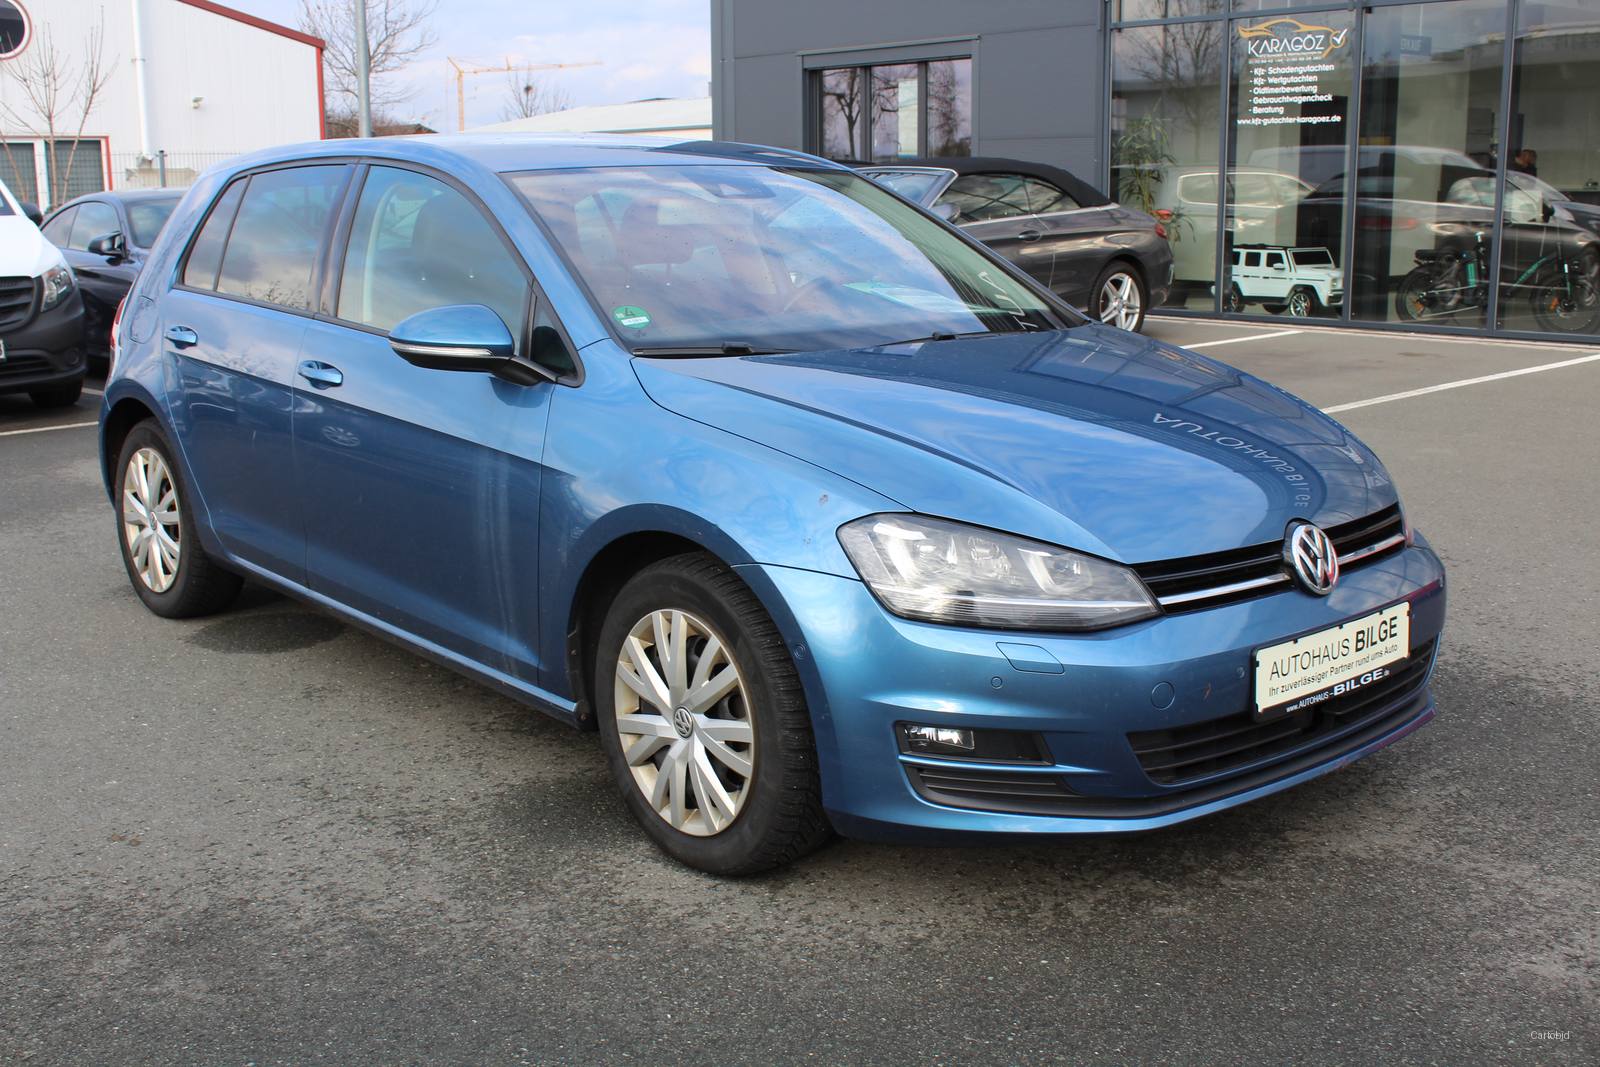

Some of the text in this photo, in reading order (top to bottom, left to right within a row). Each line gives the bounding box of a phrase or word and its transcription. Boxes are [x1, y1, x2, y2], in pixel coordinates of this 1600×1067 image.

[1248, 35, 1325, 57] KARAGÖZ
[1268, 64, 1335, 75] Schadengutachten
[1268, 75, 1318, 85] Wertgutachten
[1253, 84, 1318, 94] Oldtimerbewertung
[1253, 93, 1333, 104] Gebrauchtwagencheck
[1253, 105, 1285, 114] Beratung
[1237, 114, 1341, 126] www.kfz-gutachter-karagoez.de
[1270, 616, 1398, 681] AUTOHAUS BILGE
[1268, 644, 1398, 697] Ihr zuverlässiger Partner rund ums Auto
